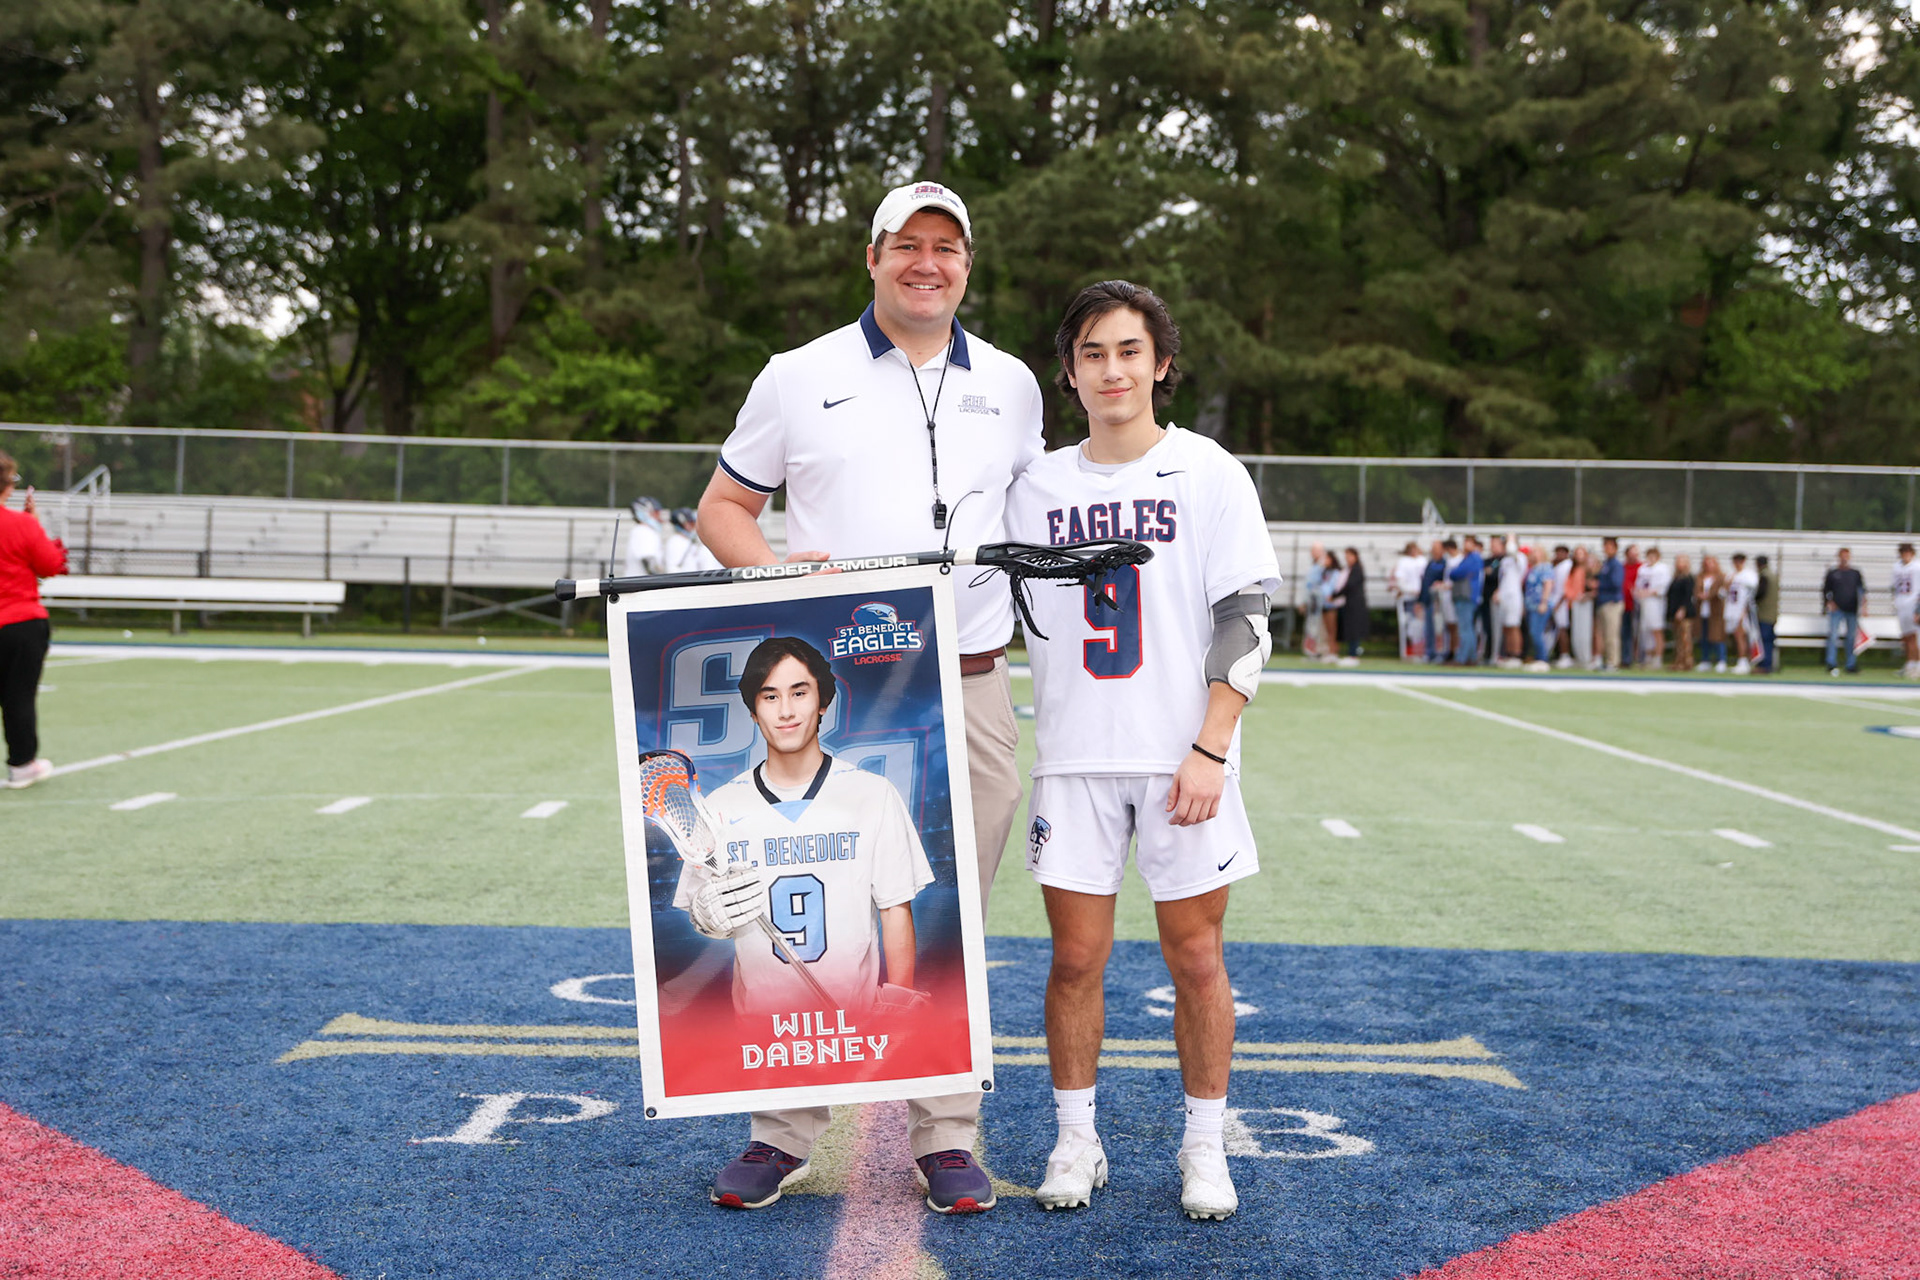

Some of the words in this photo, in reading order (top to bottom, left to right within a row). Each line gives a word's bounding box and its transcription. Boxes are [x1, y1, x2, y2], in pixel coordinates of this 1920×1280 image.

[1047, 499, 1177, 545] EAGLES
[742, 564, 812, 580] UNDER
[819, 555, 908, 573] ARMOUR
[840, 627, 856, 638] ST.
[858, 622, 912, 634] BENEDICT
[1083, 564, 1143, 680] 9
[833, 632, 922, 657] EAGLES
[854, 653, 902, 665] LACROSSE
[727, 840, 758, 867] ST.
[764, 832, 860, 866] BENEDICT
[769, 873, 828, 964] 9
[771, 1009, 857, 1039] WILL
[741, 1035, 889, 1069] DABNEY
[408, 1091, 619, 1145] P
